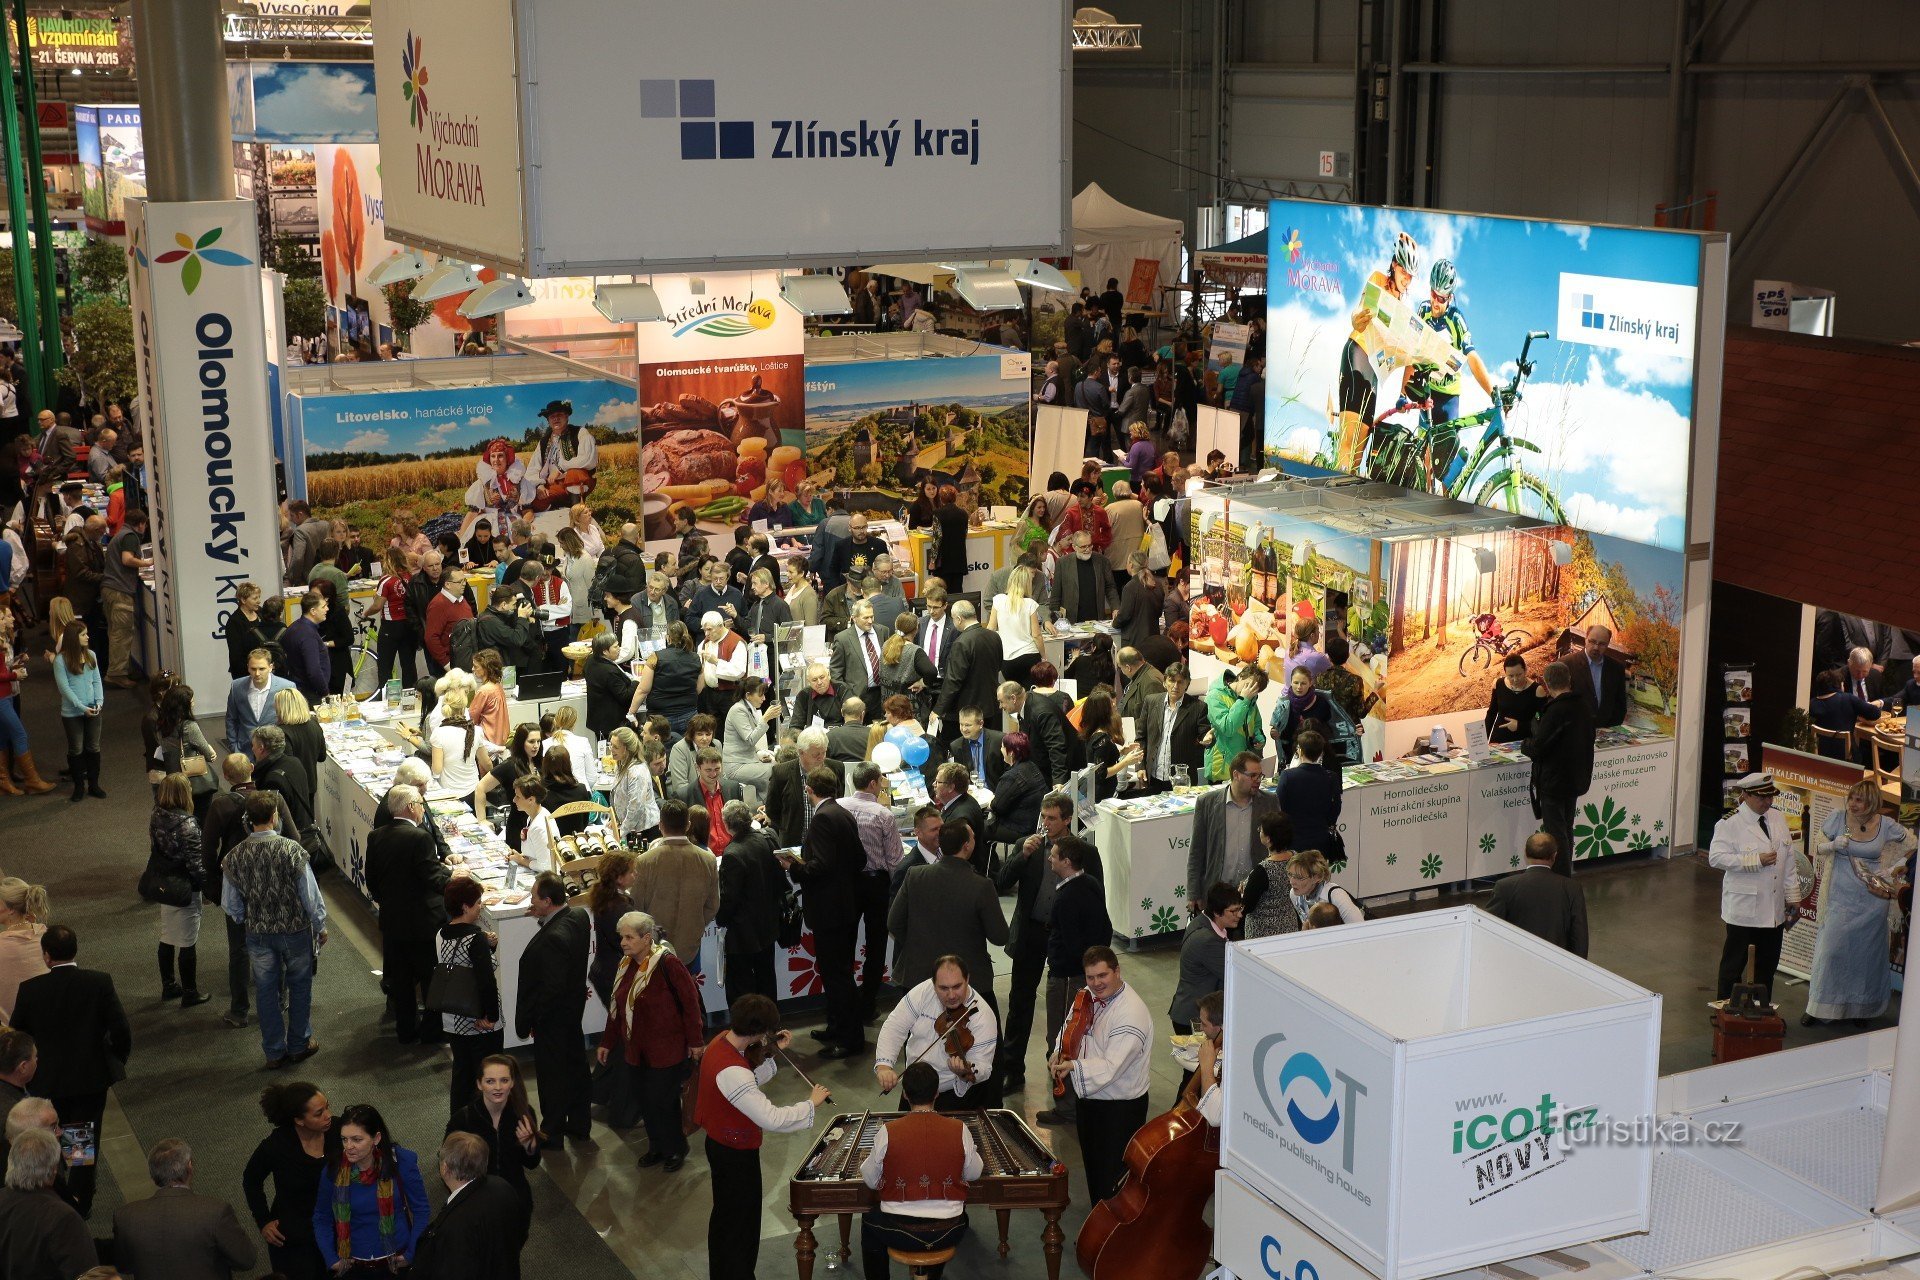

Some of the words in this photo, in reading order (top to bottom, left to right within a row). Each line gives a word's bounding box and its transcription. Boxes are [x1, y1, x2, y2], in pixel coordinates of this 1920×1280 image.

[39, 30, 118, 48] vzpomínání
[55, 48, 95, 64] ČERVNA
[96, 52, 119, 65] 2015
[430, 110, 479, 152] Východní
[771, 119, 901, 167] Zlínský
[914, 119, 980, 165] kraj
[1321, 154, 1333, 173] 15
[417, 143, 486, 207] MORAVA
[1287, 268, 1342, 294] MORAVA
[666, 297, 718, 329] Střední
[722, 290, 772, 320] Morava
[1764, 307, 1789, 317] SOU
[1608, 314, 1652, 340] Zlínský
[1655, 321, 1680, 344] kraj
[656, 366, 712, 377] Olomoucké
[714, 362, 758, 374] tvarůžky,
[760, 361, 789, 371] Loštice
[336, 408, 412, 424] Litovelsko,
[415, 405, 464, 419] hanácké
[467, 403, 494, 416] kroje
[195, 312, 250, 565] Olomoucký
[1627, 750, 1669, 763] Rožnovsko
[1622, 764, 1657, 776] muzeum
[1384, 782, 1449, 800] Hornolidečsko
[1370, 805, 1399, 816] Místní
[1401, 800, 1425, 812] akční
[1426, 795, 1461, 808] skupina
[1383, 811, 1448, 828] Hornolidečska
[1455, 1092, 1507, 1112] www.
[1243, 1111, 1274, 1139] media
[1279, 1136, 1334, 1184] publishing
[1336, 1172, 1372, 1207] house
